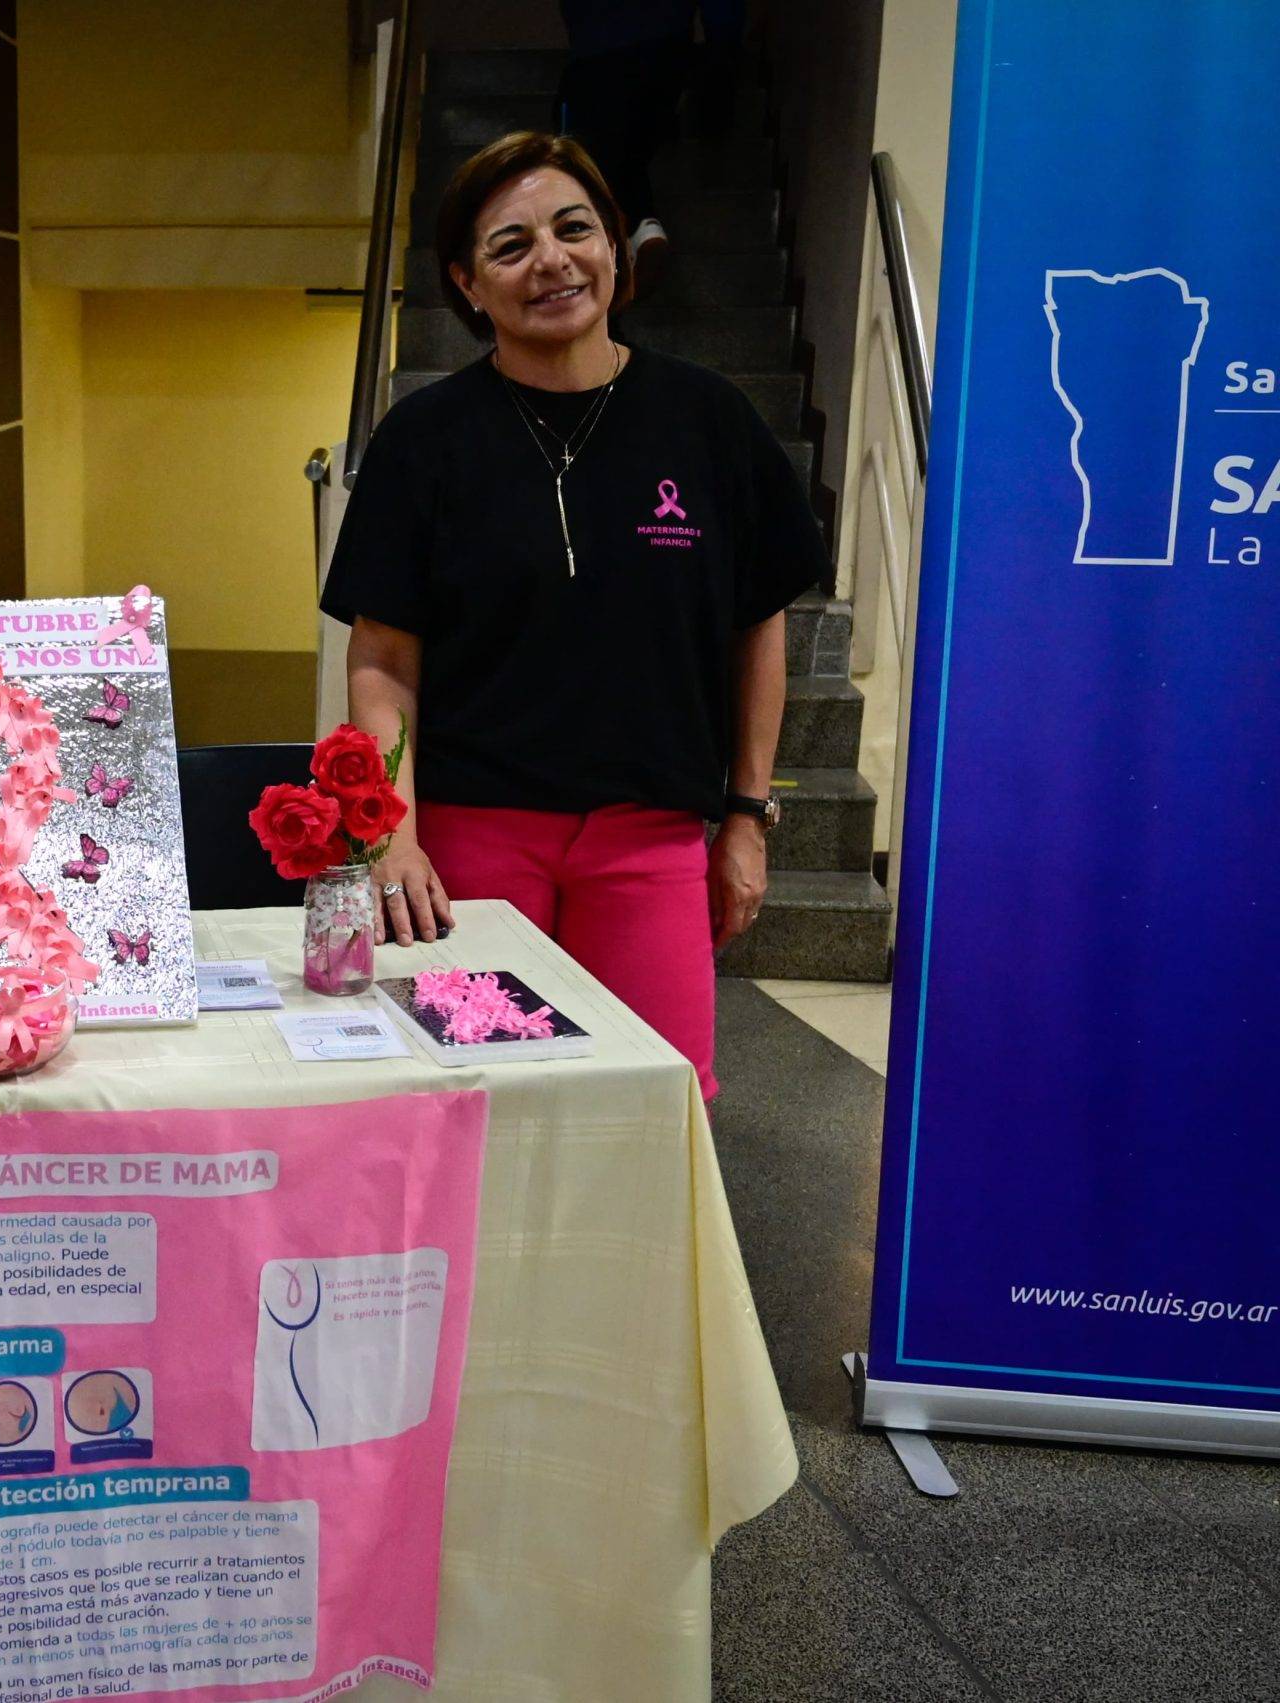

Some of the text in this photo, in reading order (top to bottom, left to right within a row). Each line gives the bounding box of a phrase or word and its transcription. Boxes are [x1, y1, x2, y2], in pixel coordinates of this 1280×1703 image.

[637, 526, 695, 536] MATERNIDAD
[650, 538, 692, 547] INFANCIA
[1208, 527, 1261, 565] La
[16, 647, 81, 669] NOS
[79, 1002, 158, 1017] Infancia
[120, 1160, 162, 1185] DE
[173, 1158, 271, 1186] MAMA
[61, 1215, 122, 1228] causada
[128, 1216, 152, 1229] por
[11, 1231, 65, 1245] células
[69, 1231, 88, 1244] de
[94, 1231, 107, 1244] la
[61, 1248, 109, 1261] Puede
[3, 1265, 102, 1282] posibilidades
[107, 1264, 127, 1277] de
[8, 1283, 51, 1297] edad,
[56, 1284, 75, 1295] en
[81, 1282, 142, 1296] especial
[1011, 1285, 1278, 1322] www.sanluis.gov.ar
[103, 1475, 230, 1497] temprana
[55, 1518, 99, 1535] puede
[103, 1513, 160, 1530] detectar
[165, 1512, 178, 1523] el
[183, 1510, 229, 1522] cáncer
[232, 1510, 250, 1521] de
[255, 1511, 298, 1522] mama
[0, 1543, 13, 1554] el
[18, 1538, 66, 1553] nódulo
[70, 1532, 122, 1547] todavía
[126, 1531, 144, 1542] no
[148, 1529, 164, 1539] es
[169, 1524, 228, 1540] palpable
[233, 1527, 241, 1538] y
[245, 1524, 280, 1537] tiene
[30, 1569, 69, 1584] casos
[74, 1567, 89, 1578] es
[94, 1560, 142, 1580] posible
[147, 1556, 198, 1571] recurrir
[203, 1556, 212, 1566] a
[217, 1553, 305, 1568] tratamientos
[69, 1583, 96, 1596] que
[101, 1580, 120, 1593] los
[124, 1575, 150, 1590] que
[154, 1576, 170, 1586] se
[175, 1570, 228, 1585] realizan
[233, 1569, 284, 1583] cuando
[288, 1568, 300, 1579] el
[20, 1602, 63, 1616] mama
[66, 1597, 95, 1610] está
[100, 1595, 129, 1608] más
[133, 1588, 200, 1603] avanzado
[204, 1588, 212, 1599] y
[217, 1585, 252, 1598] tiene
[256, 1587, 273, 1597] un
[8, 1614, 81, 1634] posibilidad
[85, 1612, 103, 1625] de
[107, 1605, 169, 1623] curación.
